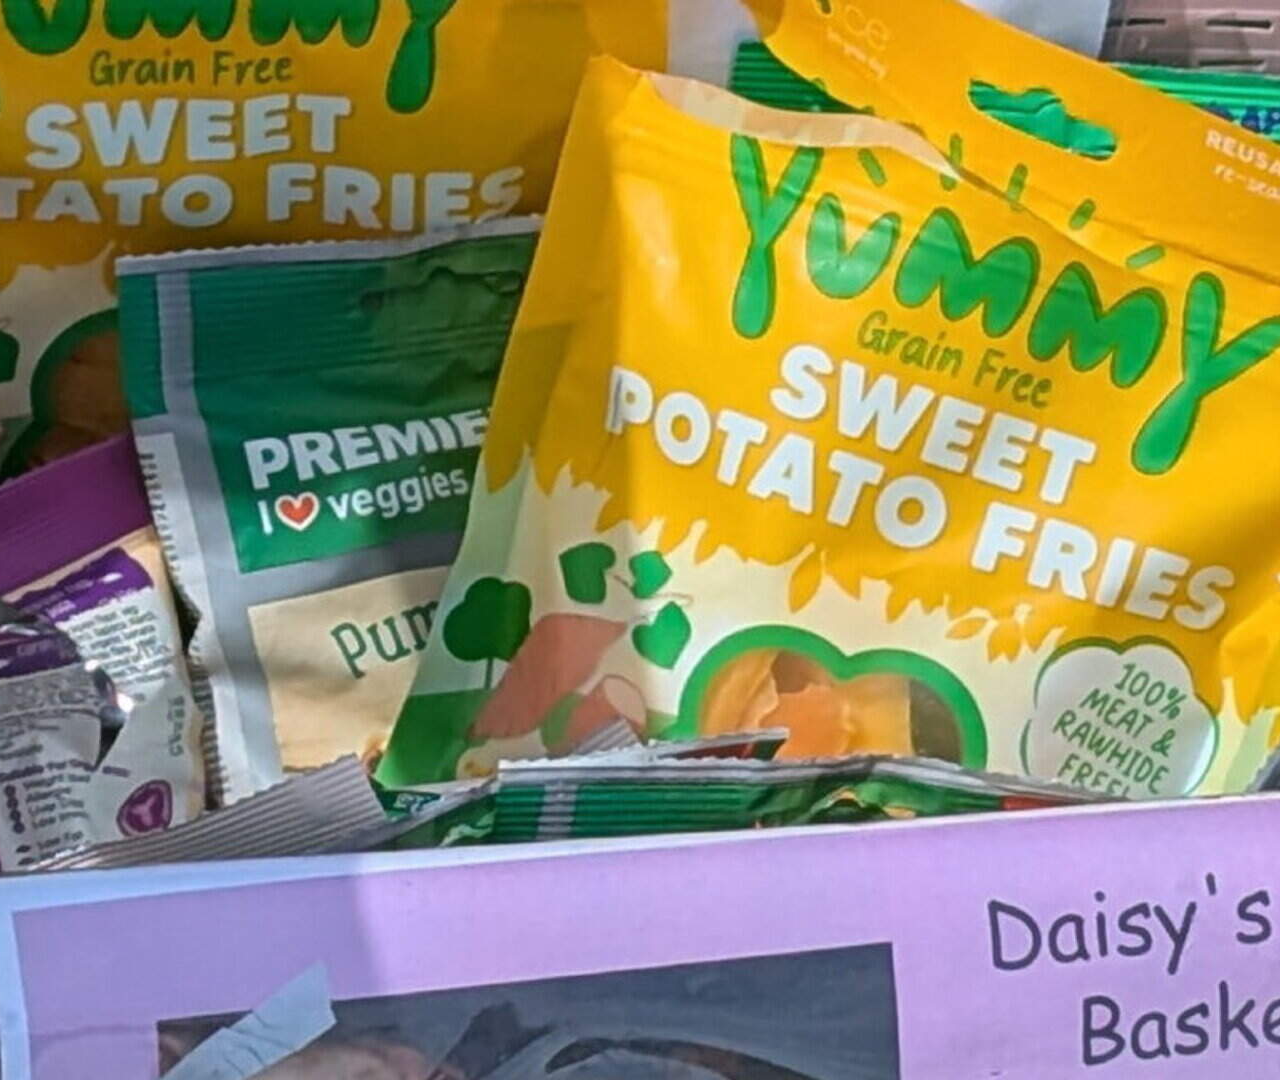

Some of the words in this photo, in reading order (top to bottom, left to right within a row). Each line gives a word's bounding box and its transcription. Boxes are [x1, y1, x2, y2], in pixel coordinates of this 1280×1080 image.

[90, 49, 196, 87] Grain
[212, 50, 294, 83] Free
[24, 94, 353, 170] SWEET
[266, 160, 526, 232] FRIES
[857, 310, 962, 378] Grain
[974, 346, 1054, 410] Free
[243, 408, 490, 490] PREMIE
[770, 343, 1096, 504] SWEET
[327, 468, 469, 519] veggies
[605, 365, 948, 549] POTATO
[971, 501, 1236, 631] FRIES
[1080, 688, 1152, 738] MEAT
[1151, 729, 1176, 757] &
[1115, 663, 1187, 719] 100%
[1052, 709, 1169, 795] RAWHIDE
[987, 872, 1272, 976] Daisy's
